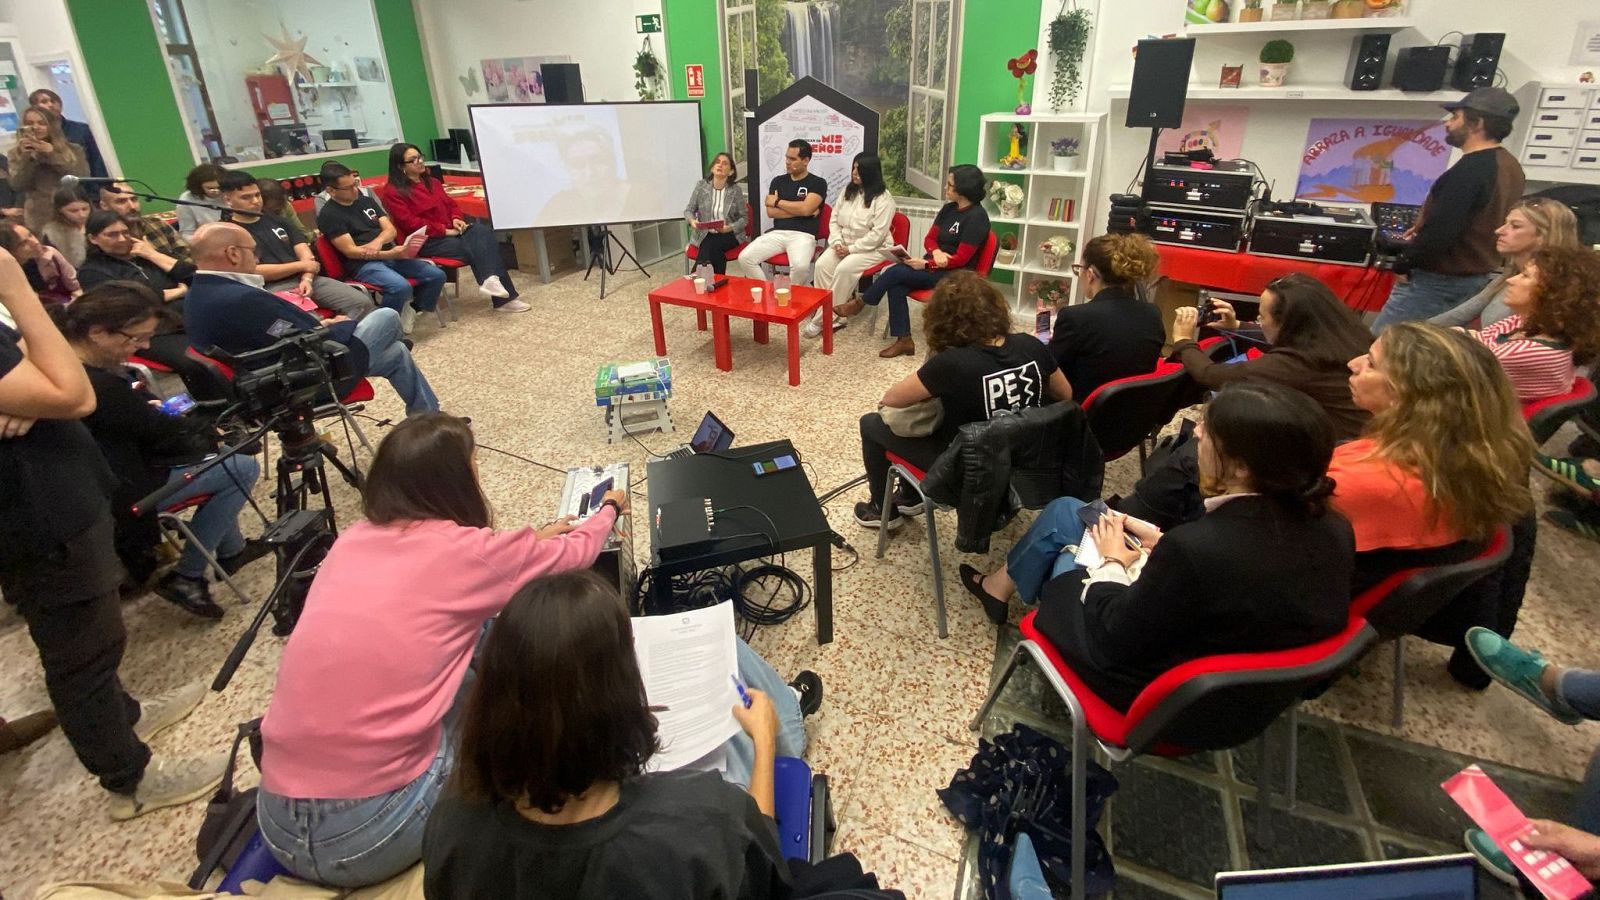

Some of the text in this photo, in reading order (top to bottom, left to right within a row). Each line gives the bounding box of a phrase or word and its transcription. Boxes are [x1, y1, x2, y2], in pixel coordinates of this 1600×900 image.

[821, 134, 843, 144] MIS
[1303, 130, 1350, 165] ABRAZA
[1354, 126, 1365, 138] A
